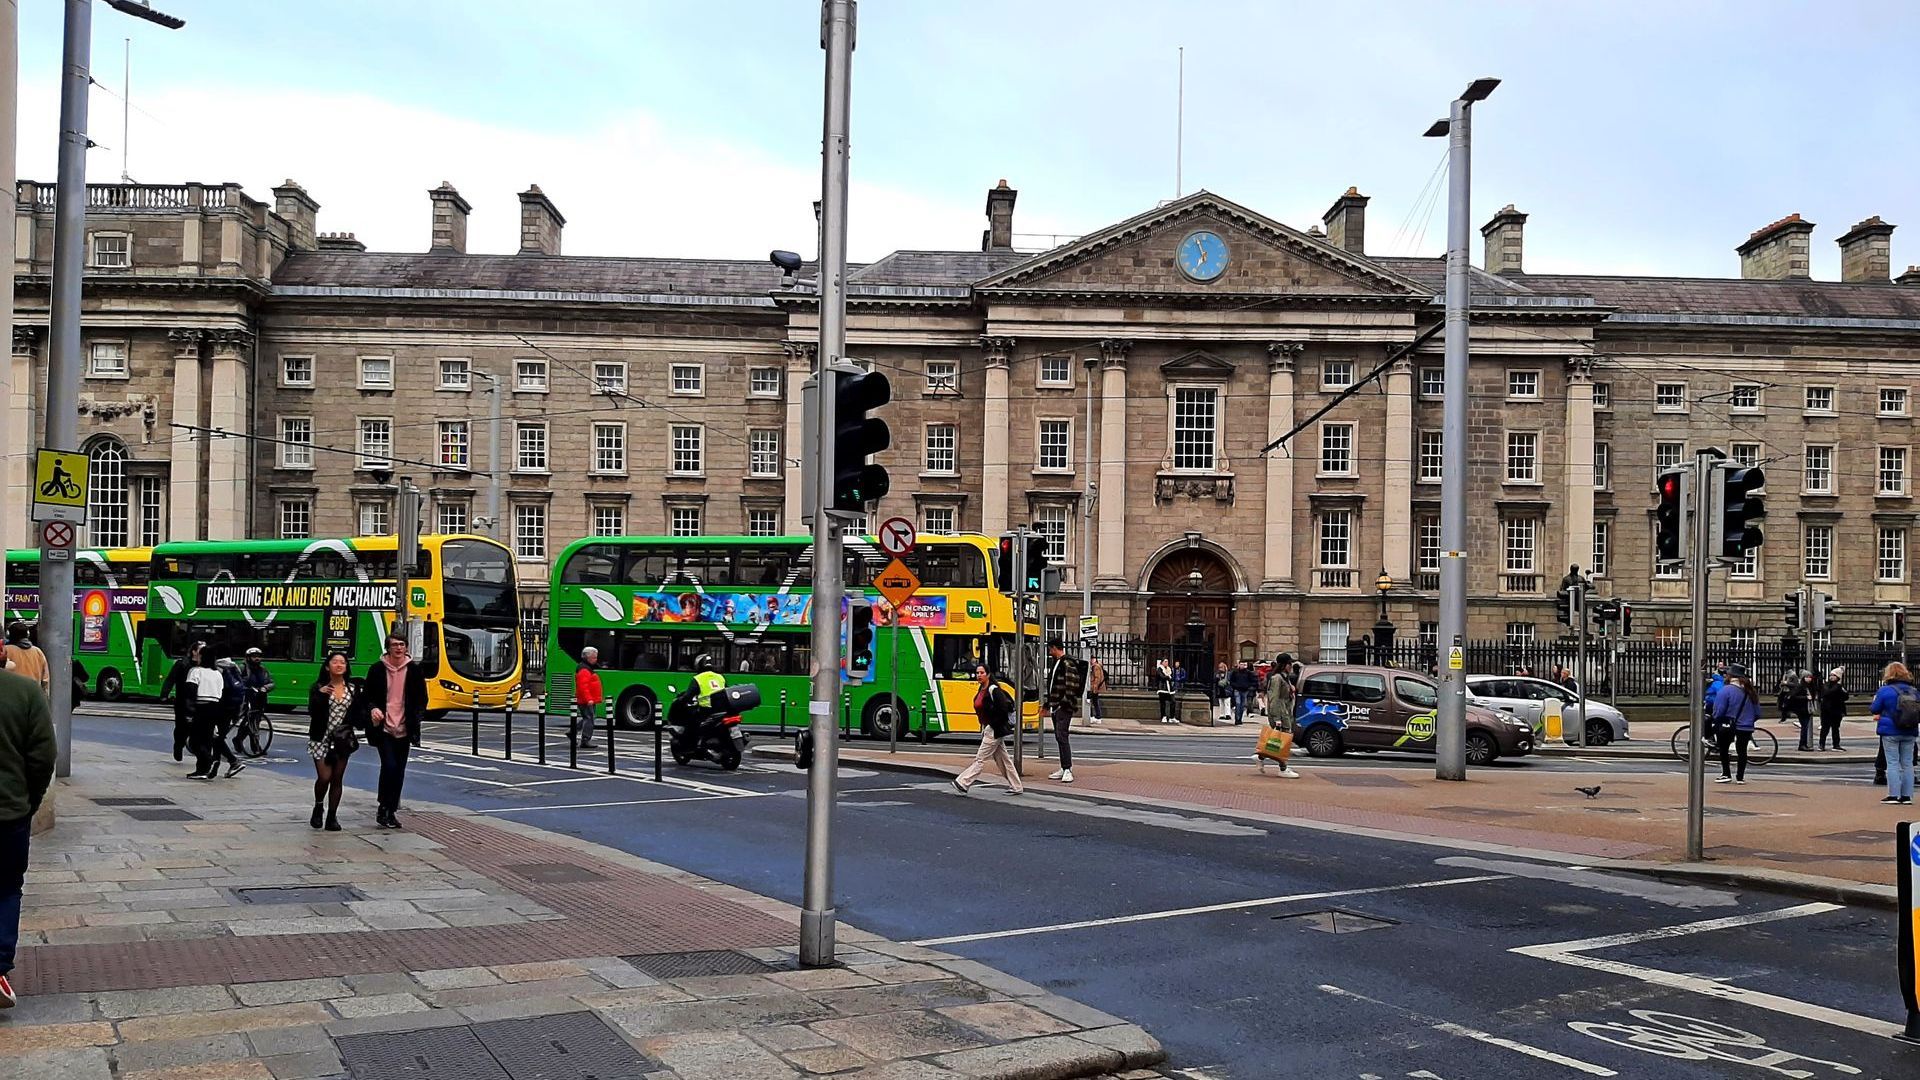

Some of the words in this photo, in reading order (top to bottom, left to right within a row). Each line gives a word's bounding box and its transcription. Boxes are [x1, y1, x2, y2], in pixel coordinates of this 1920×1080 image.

[113, 596, 147, 604] NUROFEN
[206, 587, 262, 606] RECRUITING
[263, 587, 284, 606] CAR
[285, 587, 307, 606] AND
[310, 587, 331, 606] BUS
[333, 587, 397, 607] MECHANICS
[413, 593, 425, 601] TFI
[1410, 723, 1431, 732] TAXI
